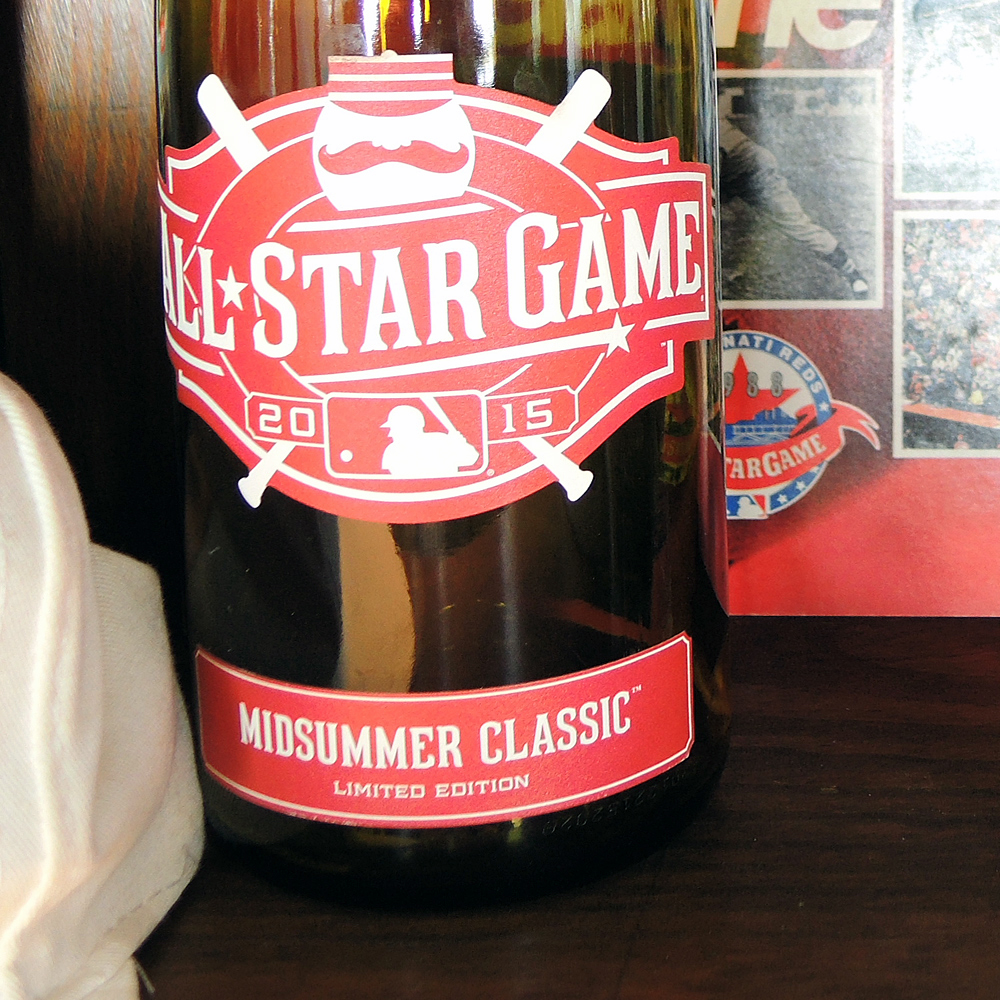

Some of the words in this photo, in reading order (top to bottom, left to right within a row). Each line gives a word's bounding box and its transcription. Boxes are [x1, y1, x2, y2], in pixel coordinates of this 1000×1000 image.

[250, 240, 484, 359] STAR
[506, 201, 702, 329] GAME
[780, 345, 824, 394] REDS
[259, 402, 315, 437] 20
[501, 398, 553, 433] 15
[239, 701, 463, 769] MIDSUMMER
[333, 780, 426, 799] LIMITED
[435, 773, 530, 799] EDITION
